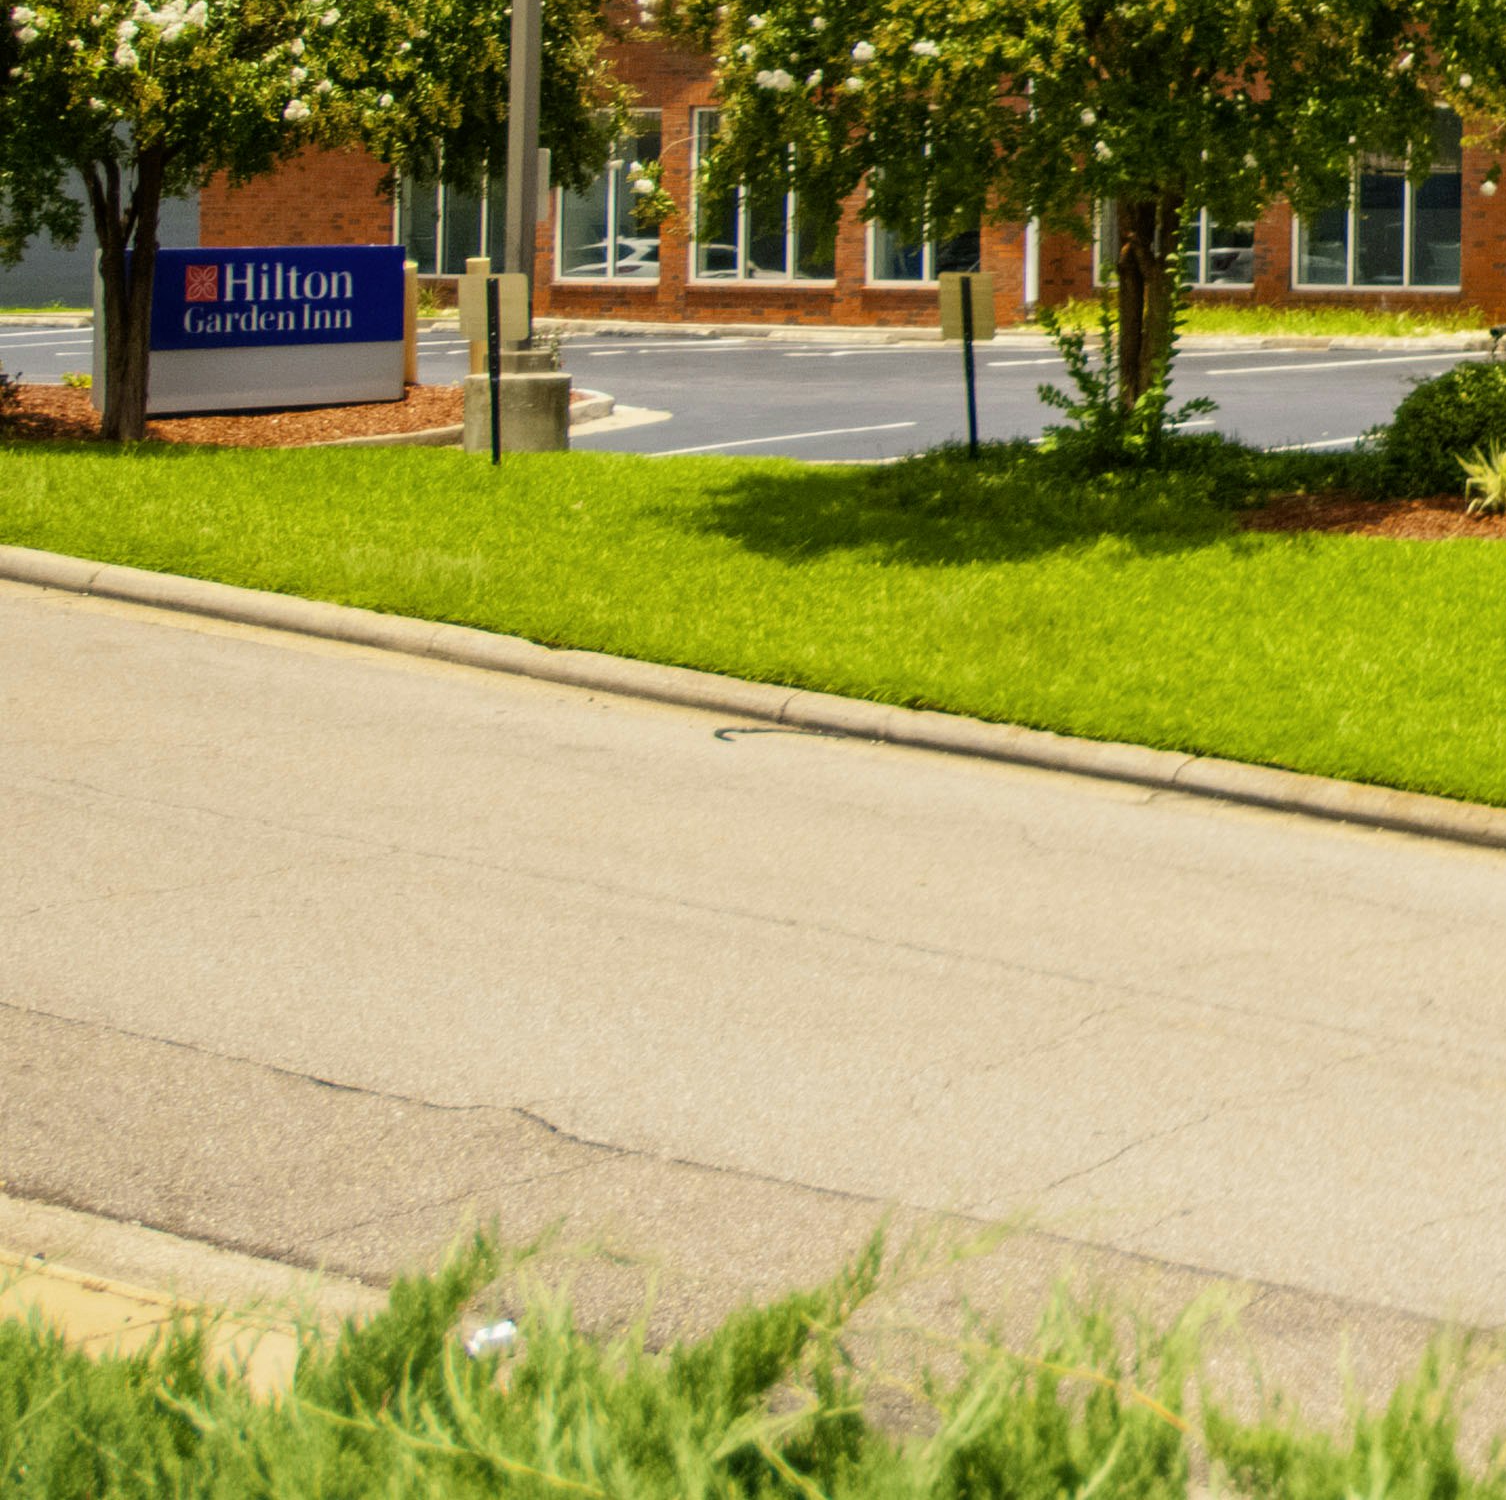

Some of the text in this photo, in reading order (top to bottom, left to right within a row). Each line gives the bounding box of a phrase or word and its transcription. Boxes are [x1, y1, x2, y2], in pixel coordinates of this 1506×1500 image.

[224, 262, 353, 302] Hilton
[184, 303, 352, 334] Garden Inn
